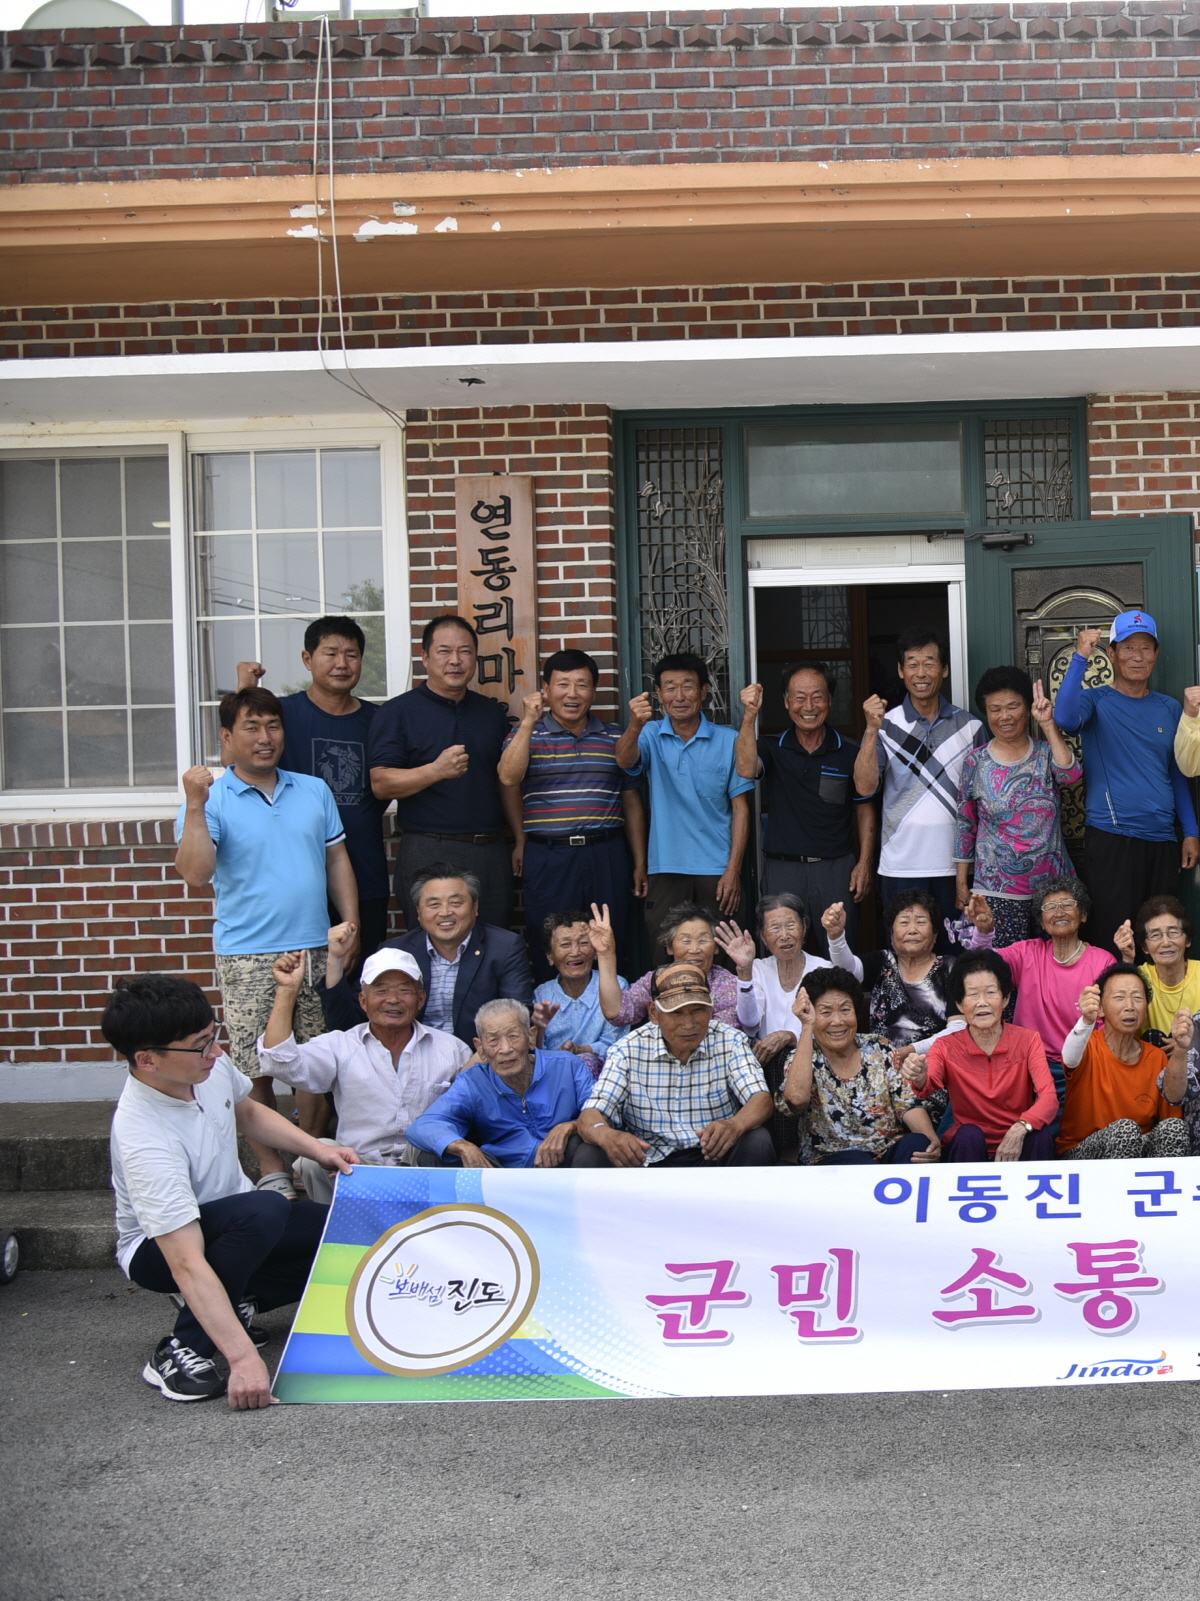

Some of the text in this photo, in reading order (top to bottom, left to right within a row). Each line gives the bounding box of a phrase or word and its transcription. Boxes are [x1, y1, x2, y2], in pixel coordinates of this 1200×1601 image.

[873, 1173, 1082, 1224] 이동진
[448, 1278, 506, 1312] 진도
[646, 1247, 860, 1342] 군민
[931, 1238, 1164, 1330] 소통
